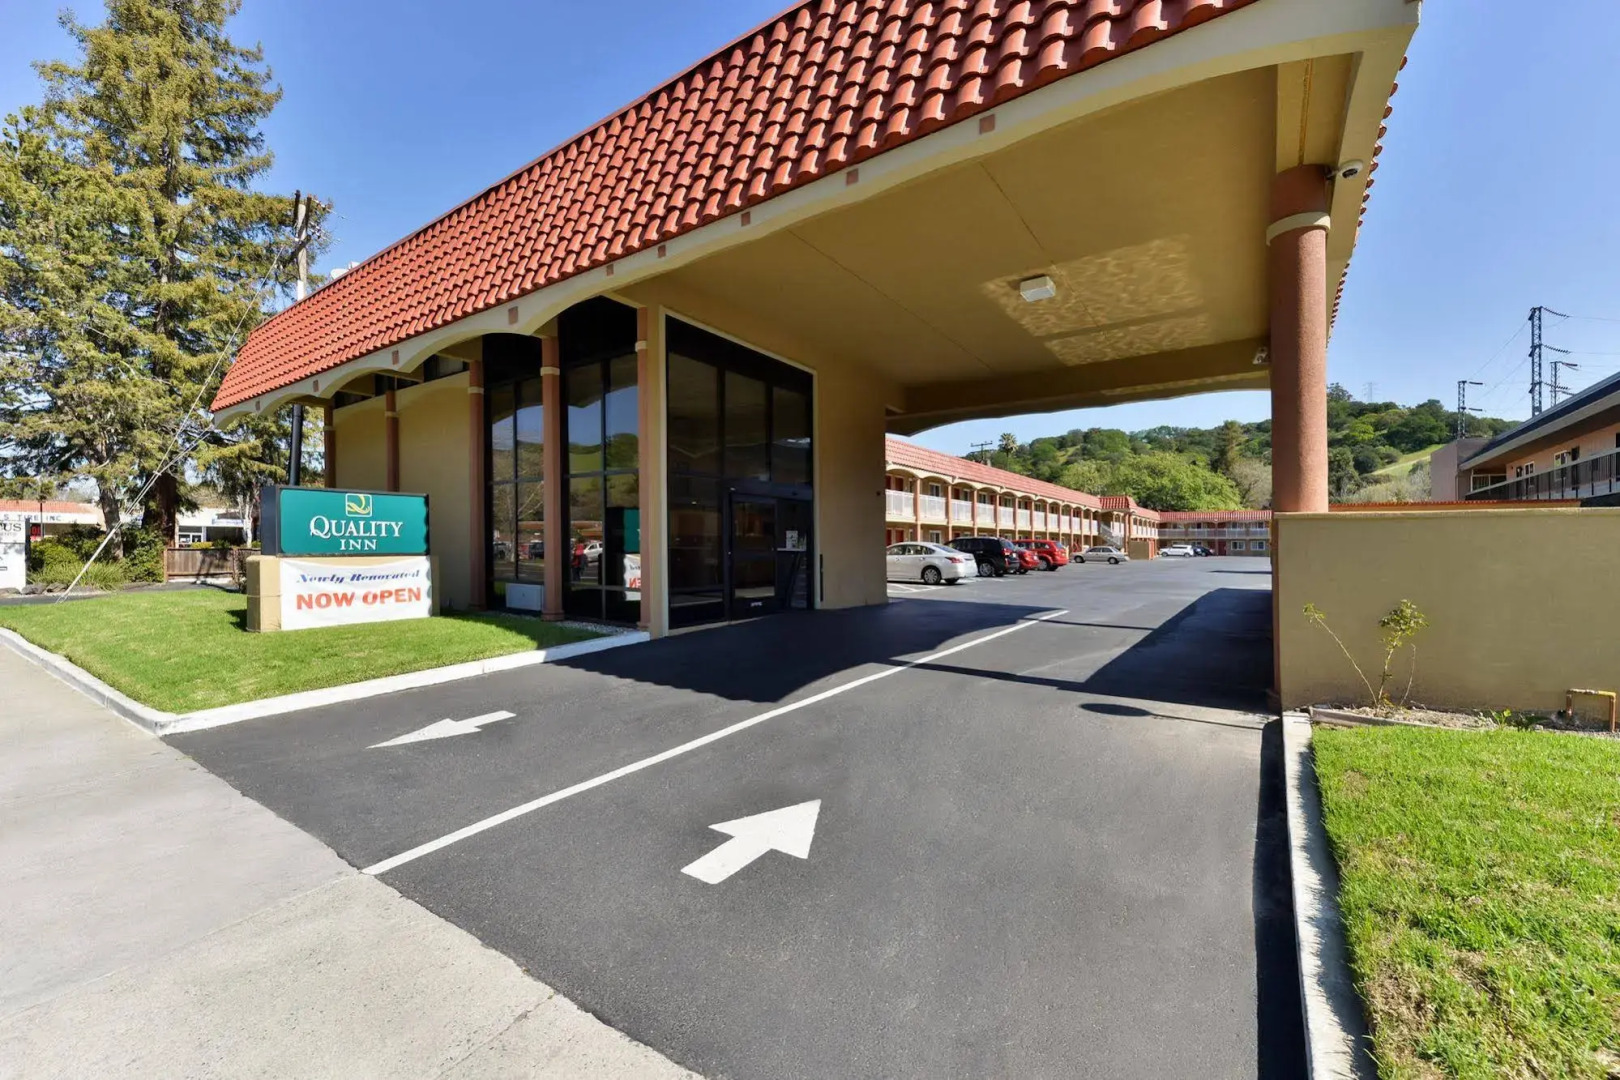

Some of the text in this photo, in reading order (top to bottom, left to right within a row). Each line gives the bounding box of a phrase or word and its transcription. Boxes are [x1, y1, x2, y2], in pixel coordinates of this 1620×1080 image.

[310, 515, 403, 539] QUALITY
[340, 539, 378, 551] INN
[297, 569, 420, 584] Newly Renovated
[296, 587, 422, 610] NOW OPEN
